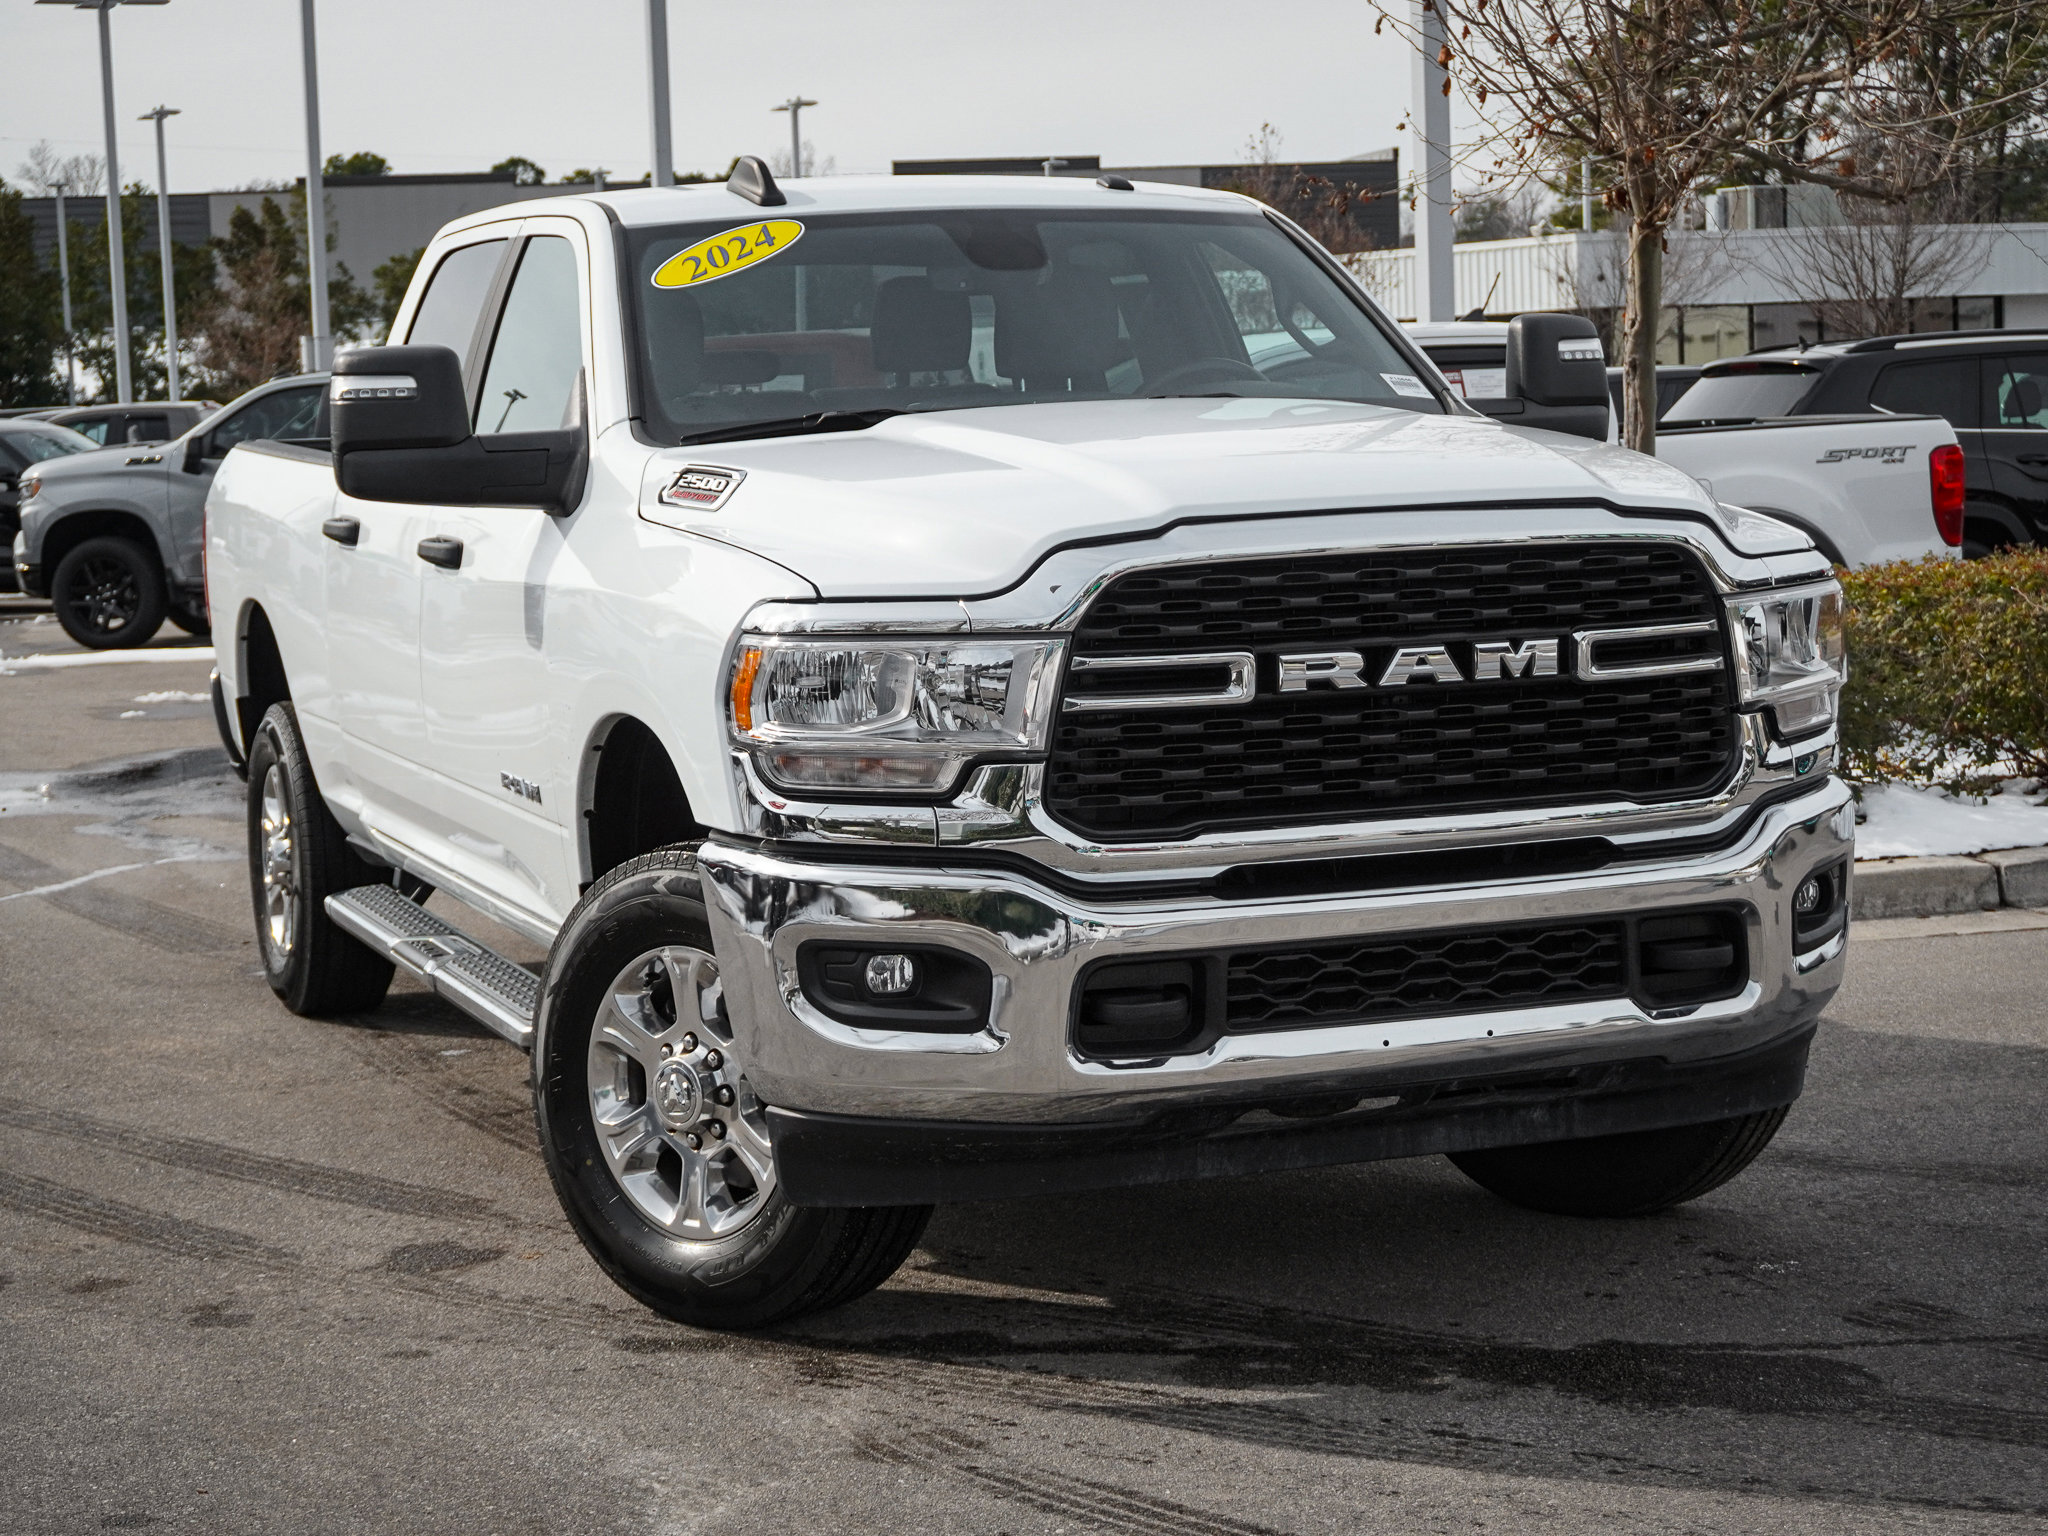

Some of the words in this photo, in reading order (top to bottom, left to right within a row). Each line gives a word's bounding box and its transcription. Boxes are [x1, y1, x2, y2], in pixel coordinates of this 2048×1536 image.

[681, 224, 776, 281] 2024
[1816, 445, 1916, 463] SPORT
[677, 474, 729, 492] 2500
[671, 490, 697, 500] HEAVY
[695, 493, 719, 503] DUTY
[1279, 638, 1559, 692] RAM
[500, 771, 543, 805] RAM
